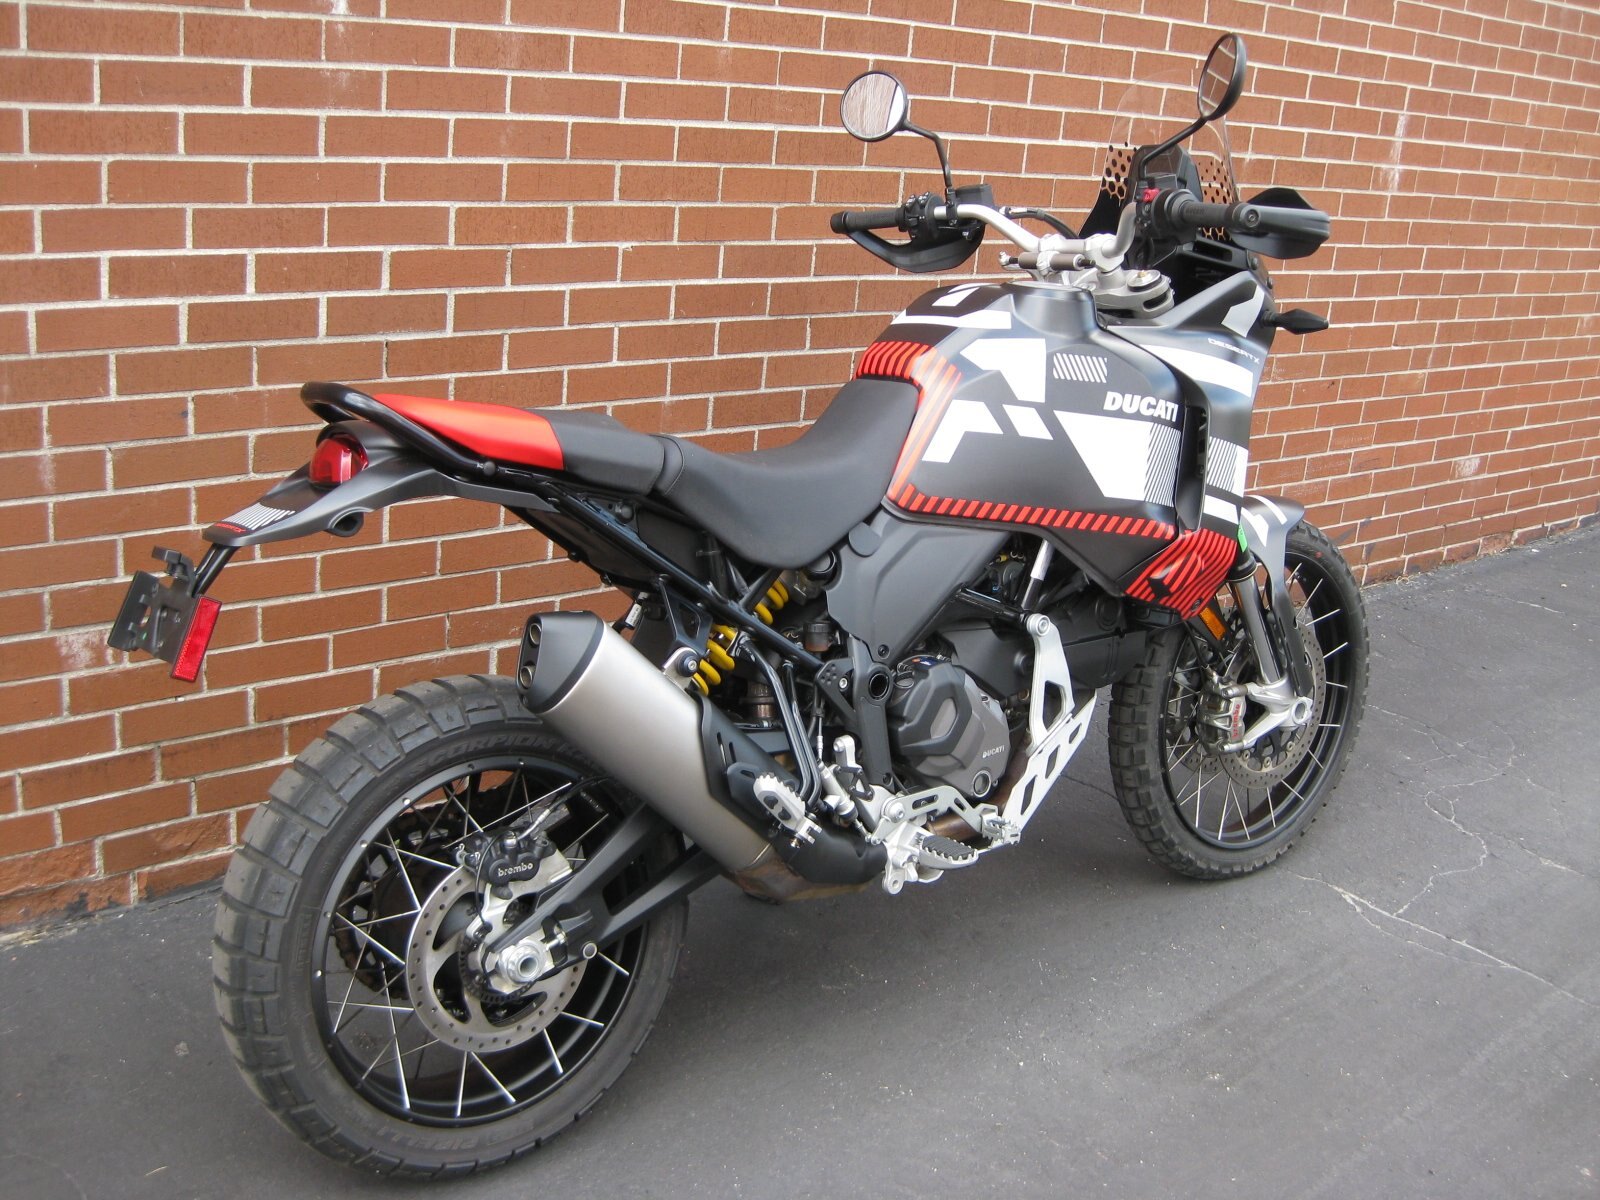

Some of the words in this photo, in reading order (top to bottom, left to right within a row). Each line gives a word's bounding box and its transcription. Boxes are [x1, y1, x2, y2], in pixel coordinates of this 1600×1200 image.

[1103, 391, 1179, 422] DUCATI
[1231, 703, 1242, 738] brembo
[409, 733, 556, 778] SCORPION
[982, 744, 1005, 759] DUCATI
[497, 862, 534, 877] brembo
